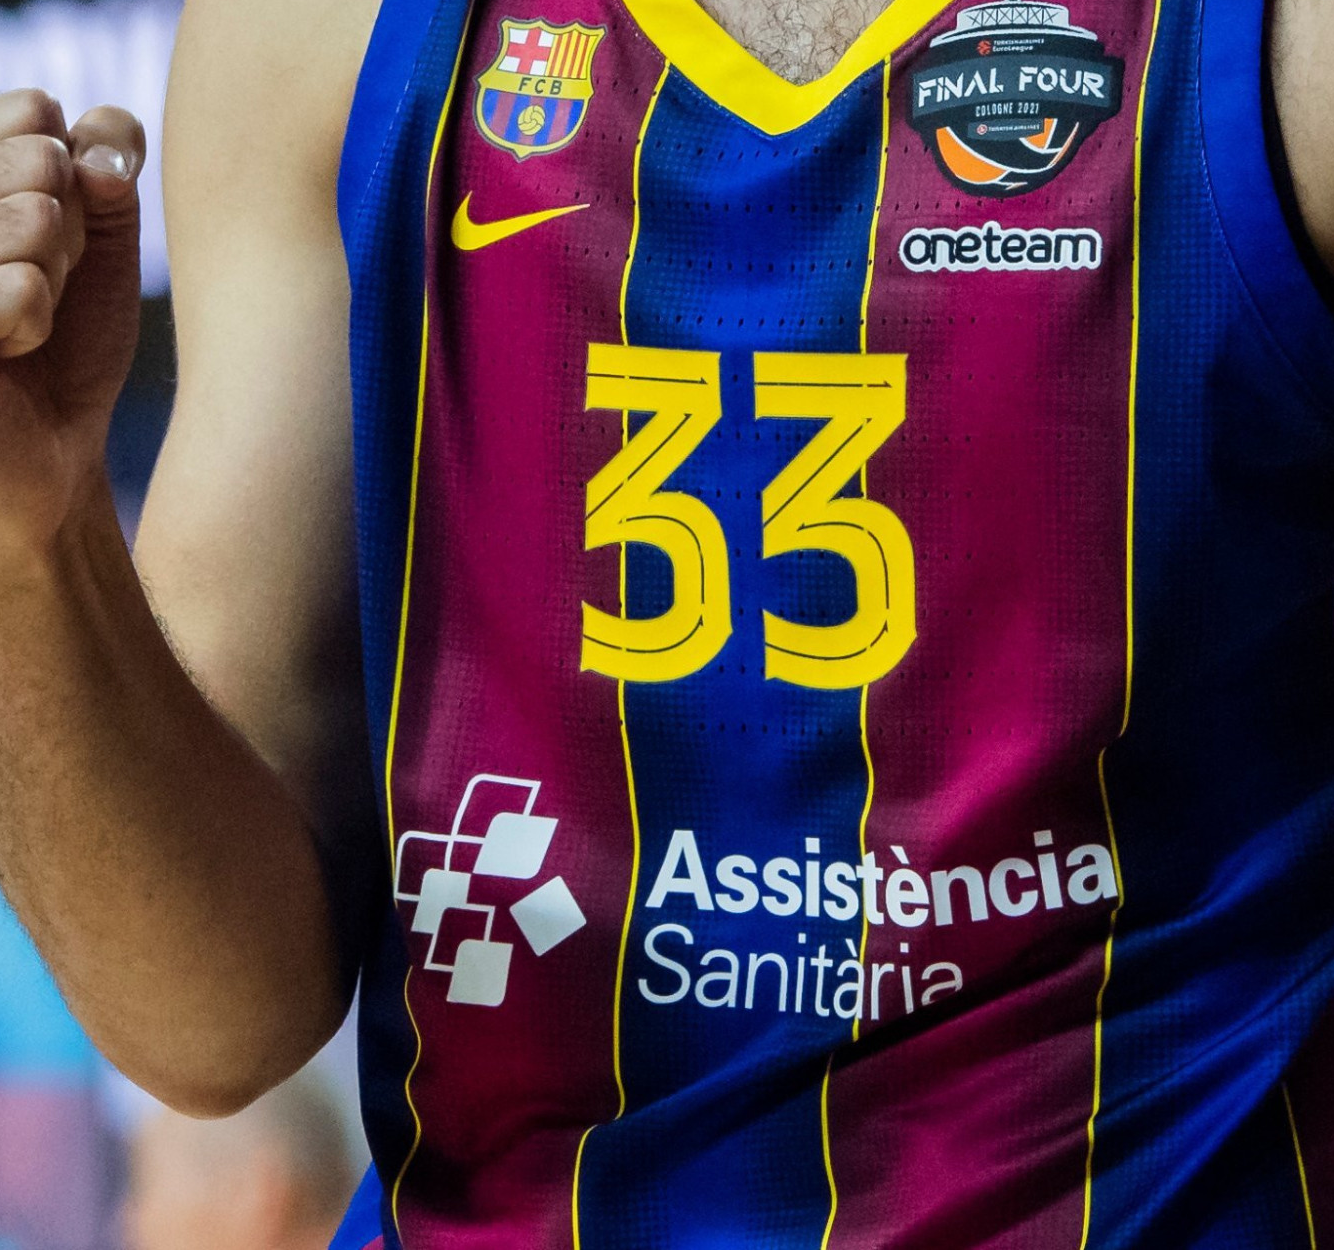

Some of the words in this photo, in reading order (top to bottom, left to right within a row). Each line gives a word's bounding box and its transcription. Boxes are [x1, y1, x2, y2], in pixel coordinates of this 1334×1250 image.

[518, 77, 563, 95] FCB
[918, 67, 1004, 108] FINAL
[1018, 66, 1105, 99] FOUR
[975, 102, 1013, 117] COLOGNE
[1017, 102, 1039, 114] 2021
[903, 226, 1097, 265] oneteam
[580, 342, 917, 690] 33
[644, 829, 1119, 928] Assistència
